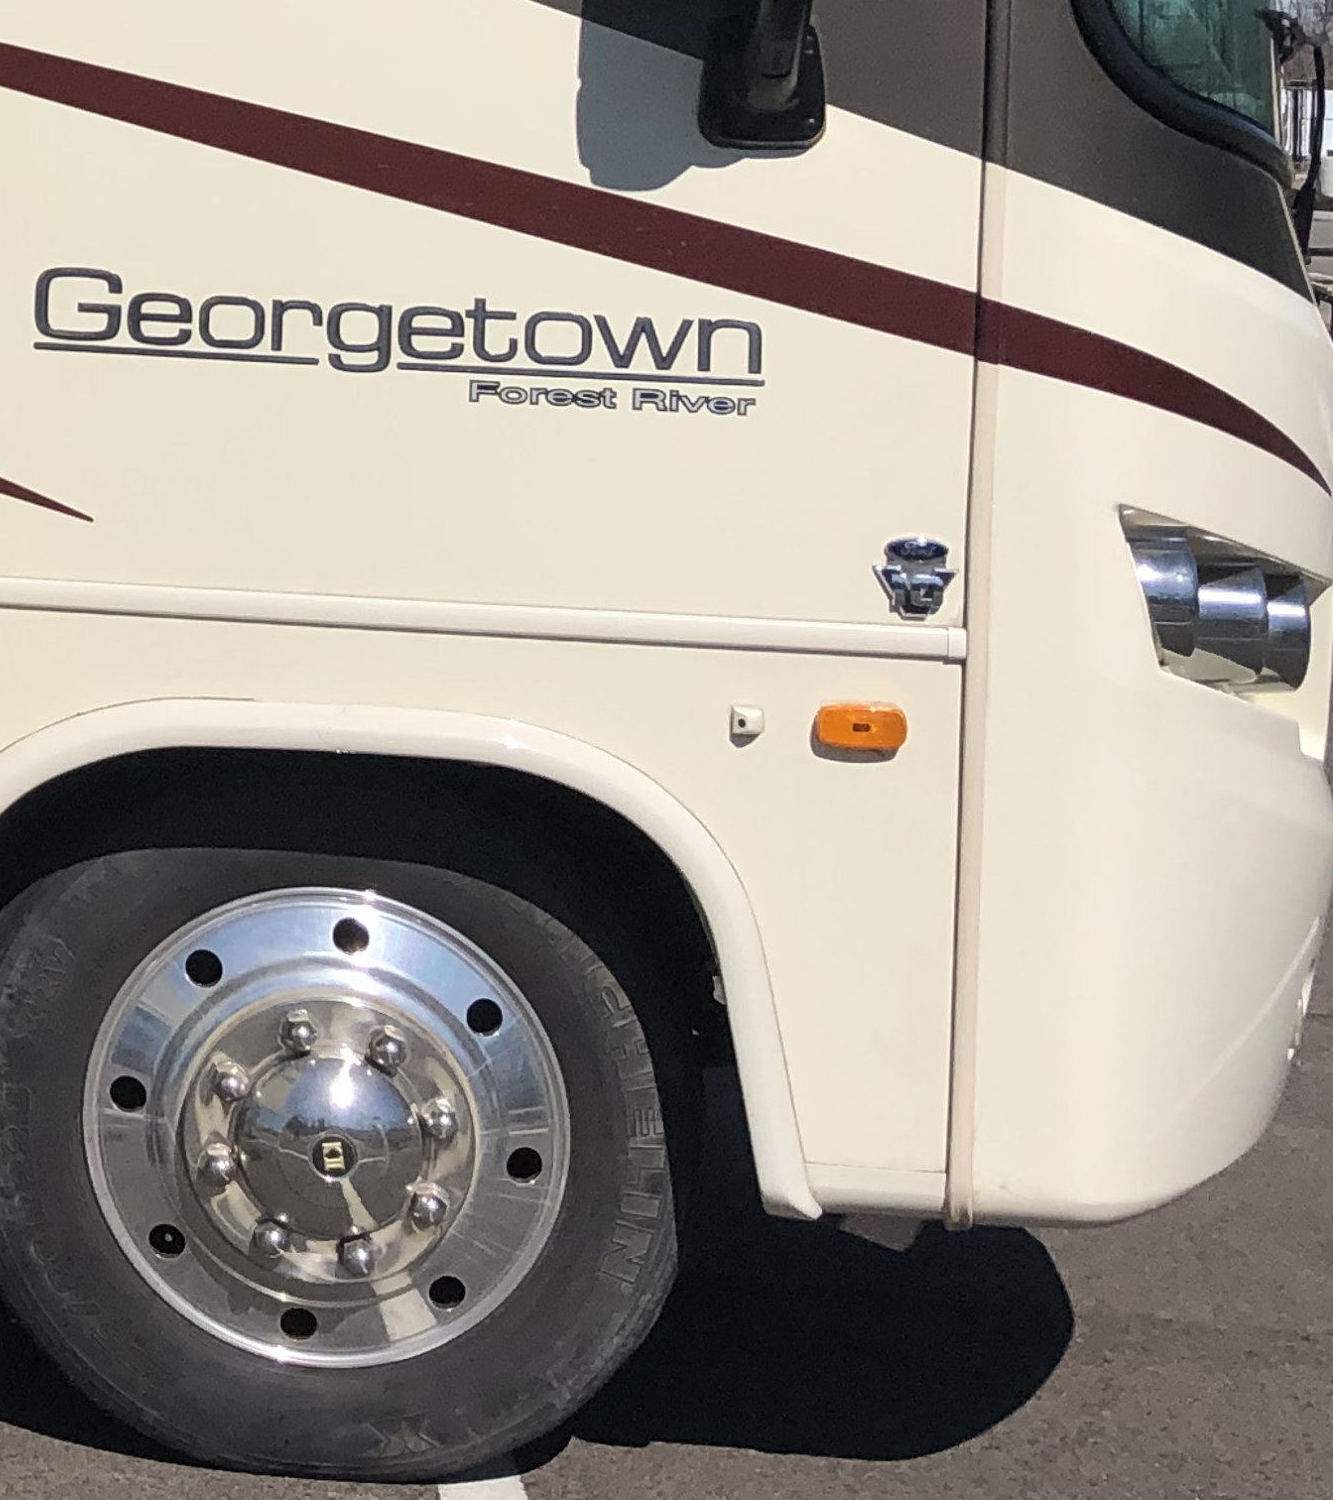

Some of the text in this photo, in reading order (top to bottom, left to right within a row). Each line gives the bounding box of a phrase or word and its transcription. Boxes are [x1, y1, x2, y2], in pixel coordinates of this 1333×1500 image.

[33, 266, 763, 374] Georgetown
[469, 379, 757, 417] Forest River
